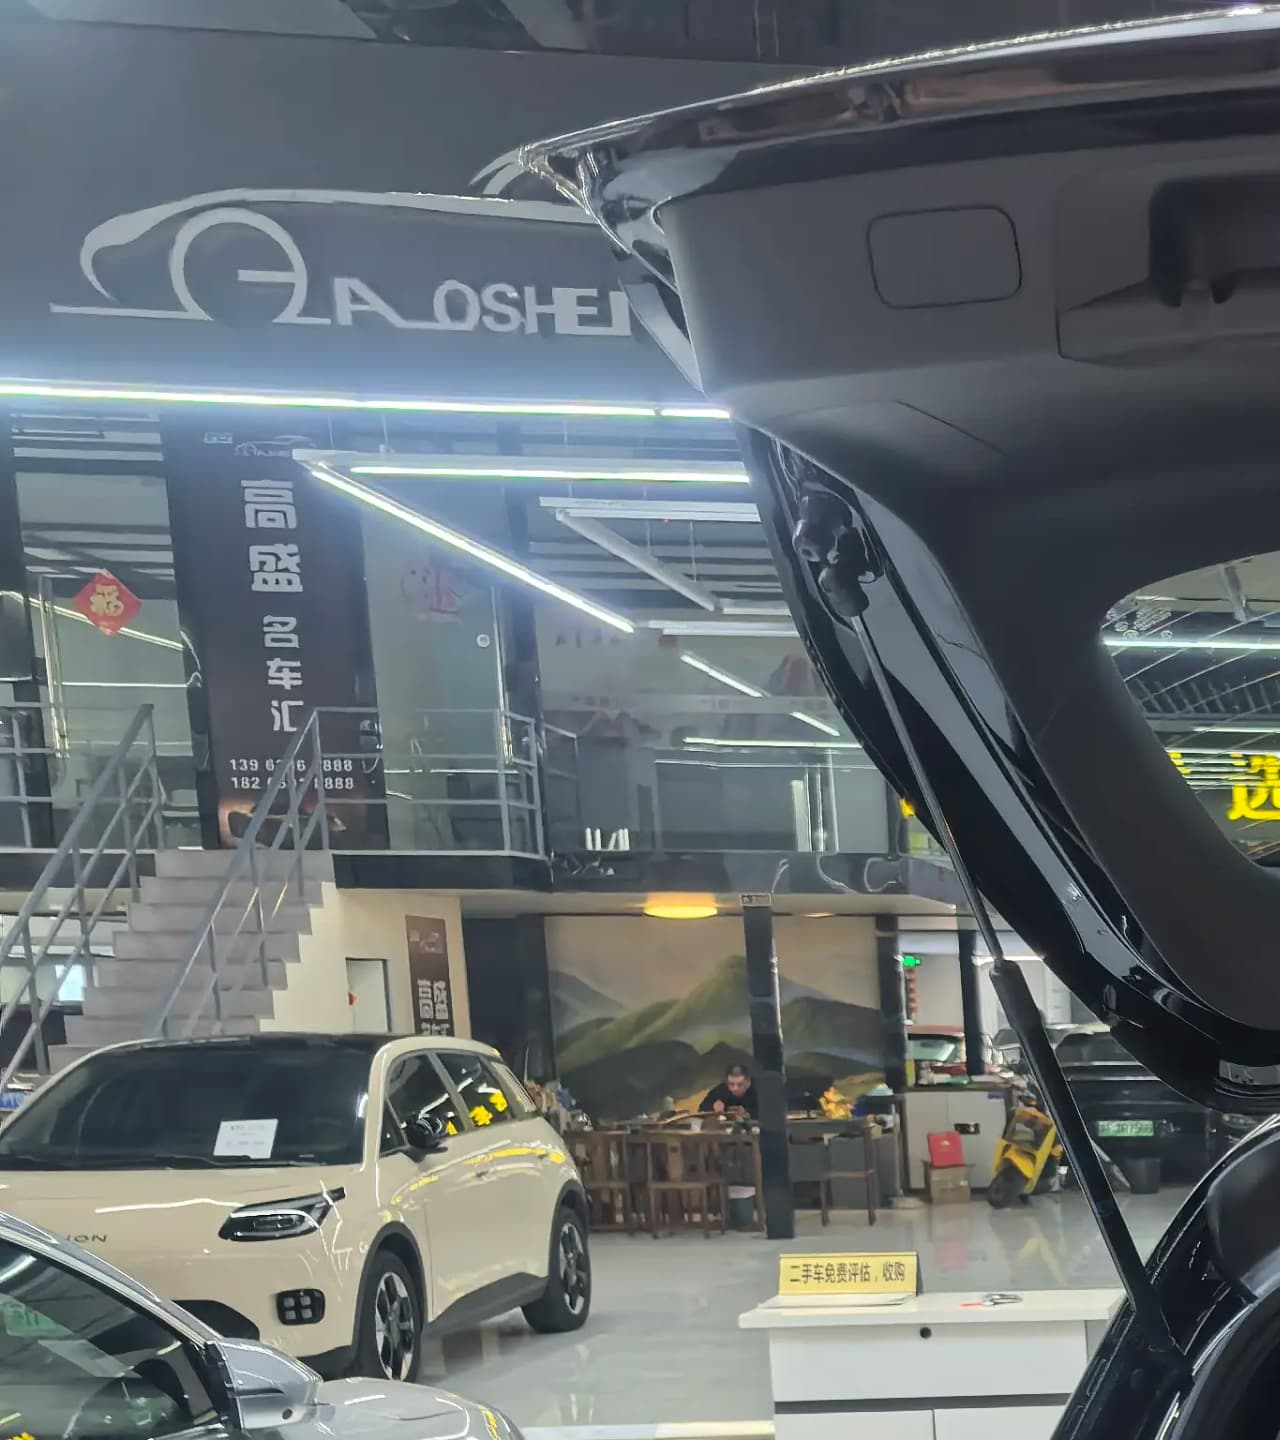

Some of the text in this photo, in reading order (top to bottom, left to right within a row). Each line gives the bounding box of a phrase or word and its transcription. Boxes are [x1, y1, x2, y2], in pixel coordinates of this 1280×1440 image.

[240, 479, 304, 733] 高盛名车汇
